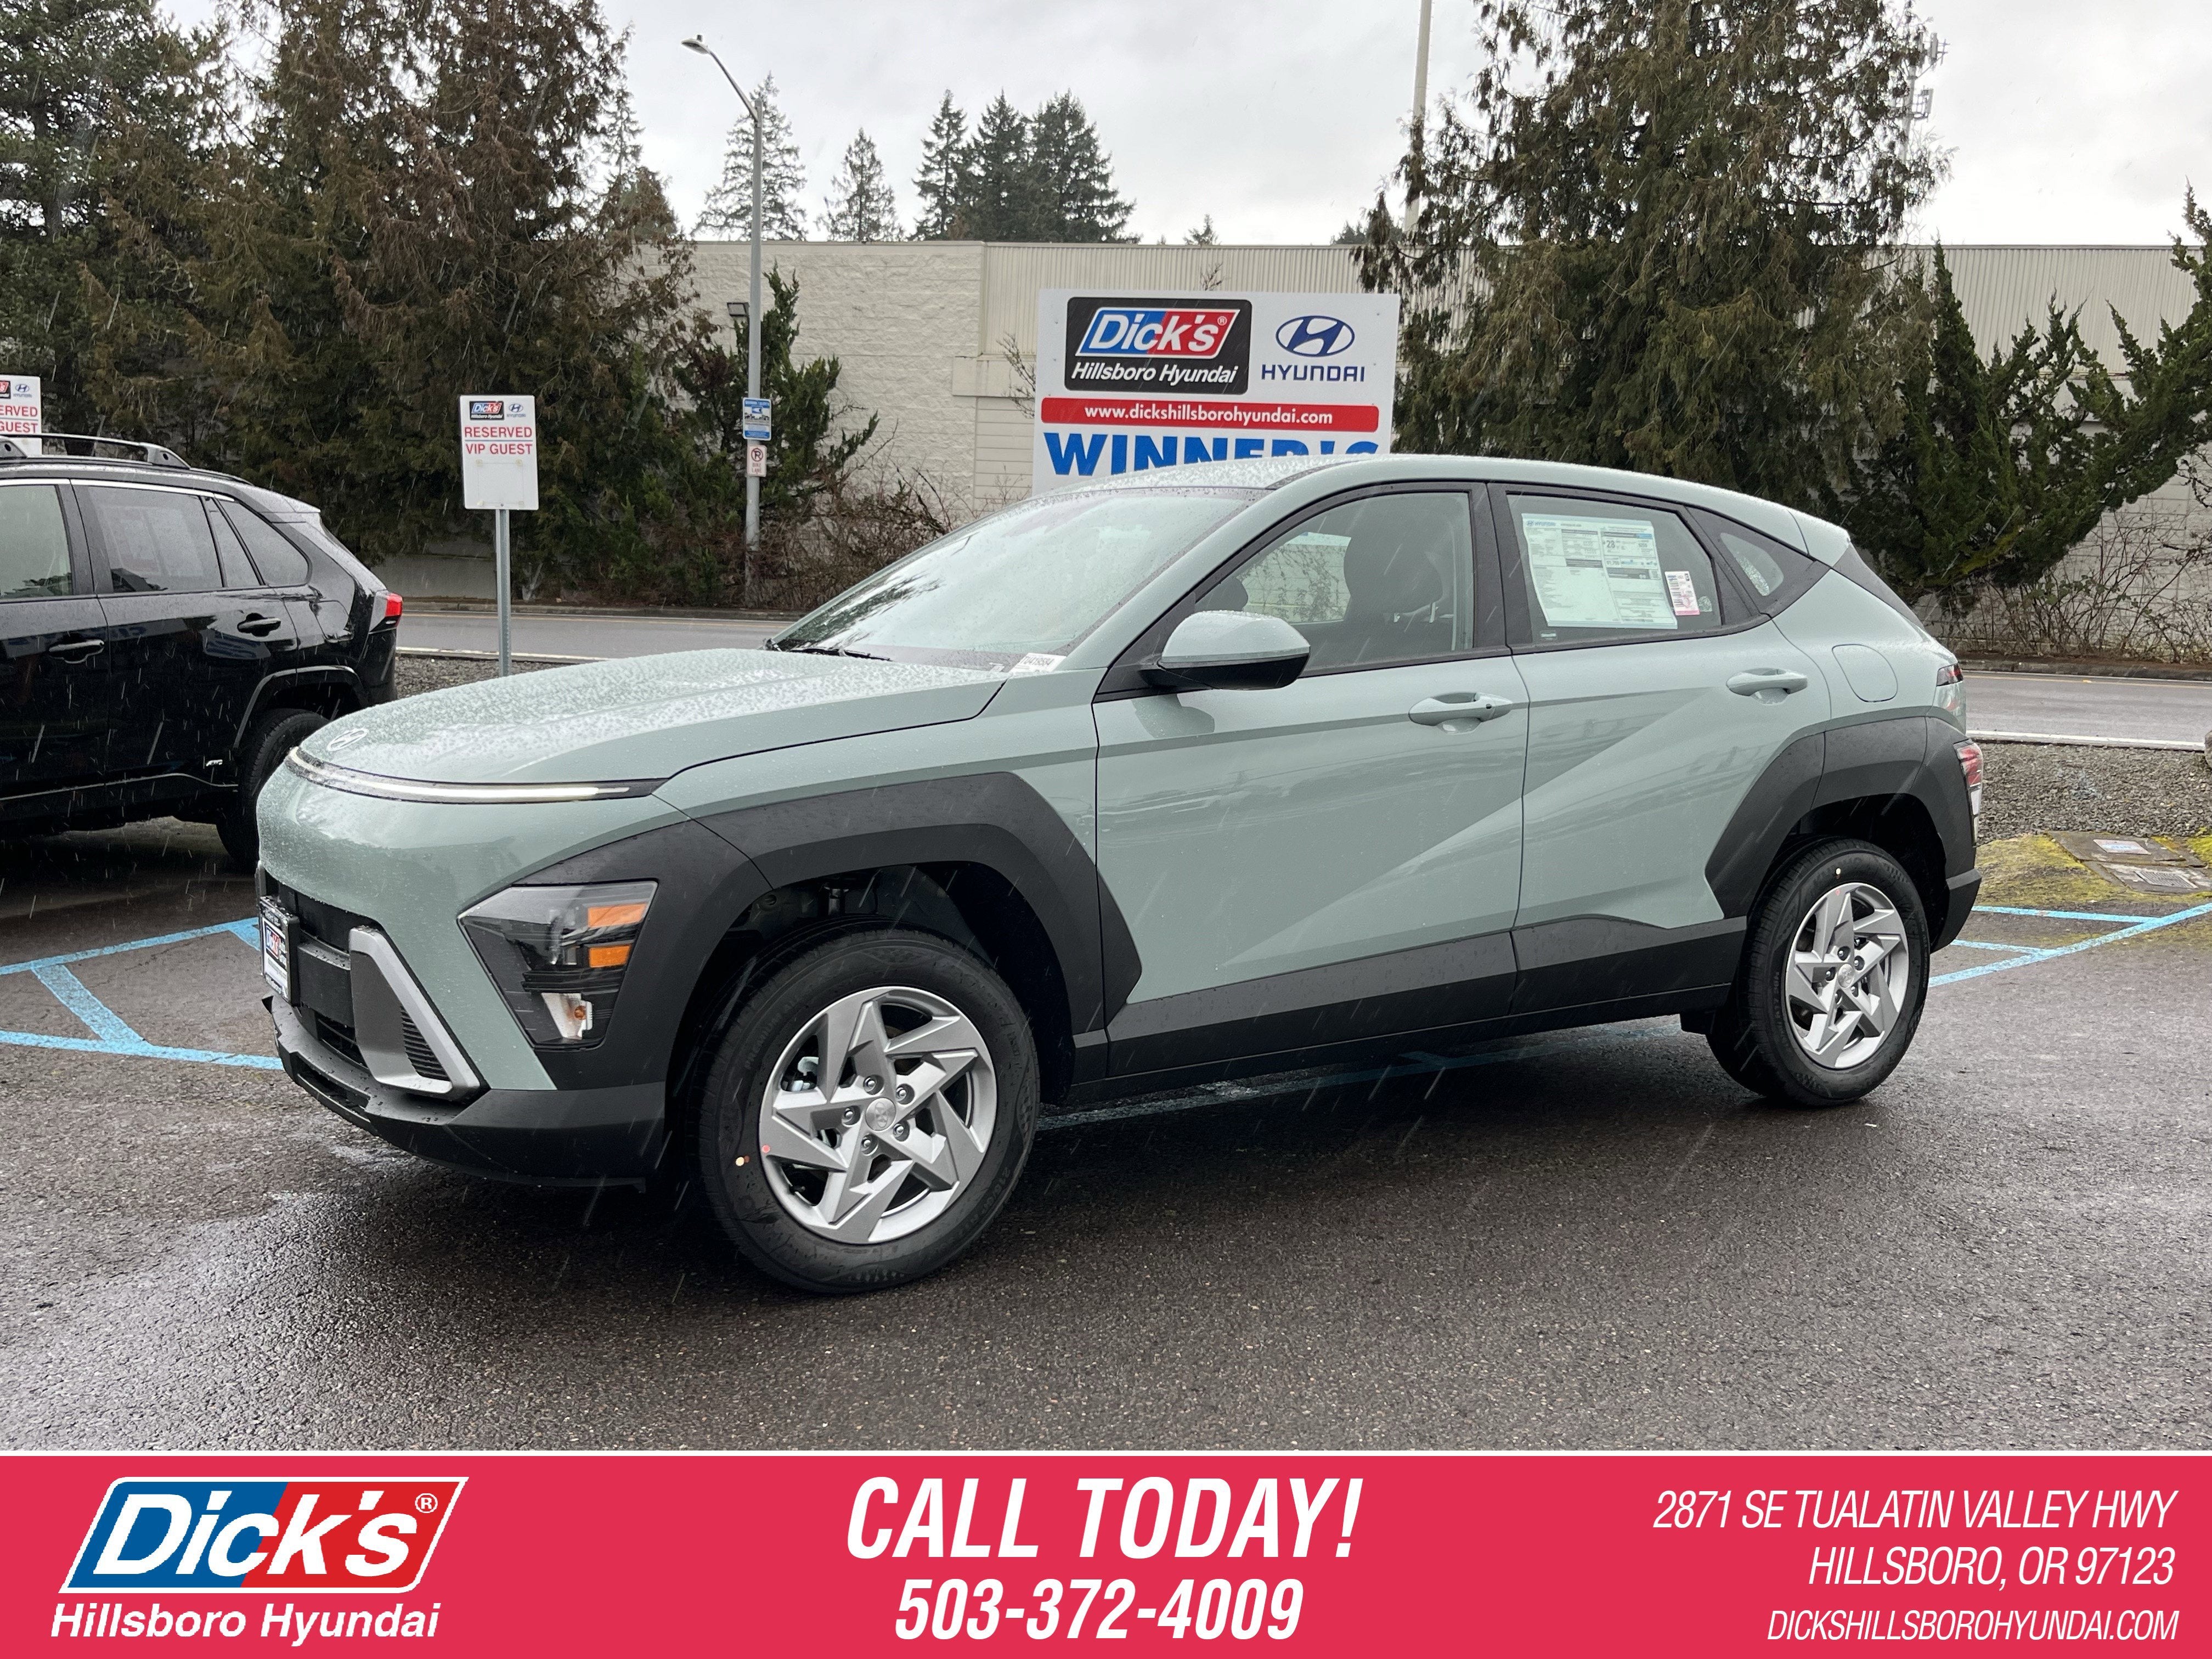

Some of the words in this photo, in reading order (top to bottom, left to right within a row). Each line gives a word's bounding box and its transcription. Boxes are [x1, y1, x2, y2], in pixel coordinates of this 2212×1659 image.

[1071, 362, 1156, 382] Hillsboro
[1159, 364, 1239, 386] Hyundai
[1262, 364, 1365, 382] HYUNDAI
[1084, 403, 1333, 425] www.dickshillsborohyundai.com
[464, 426, 532, 438] RESERVED
[465, 443, 486, 454] VIP
[489, 443, 533, 455] GUEST
